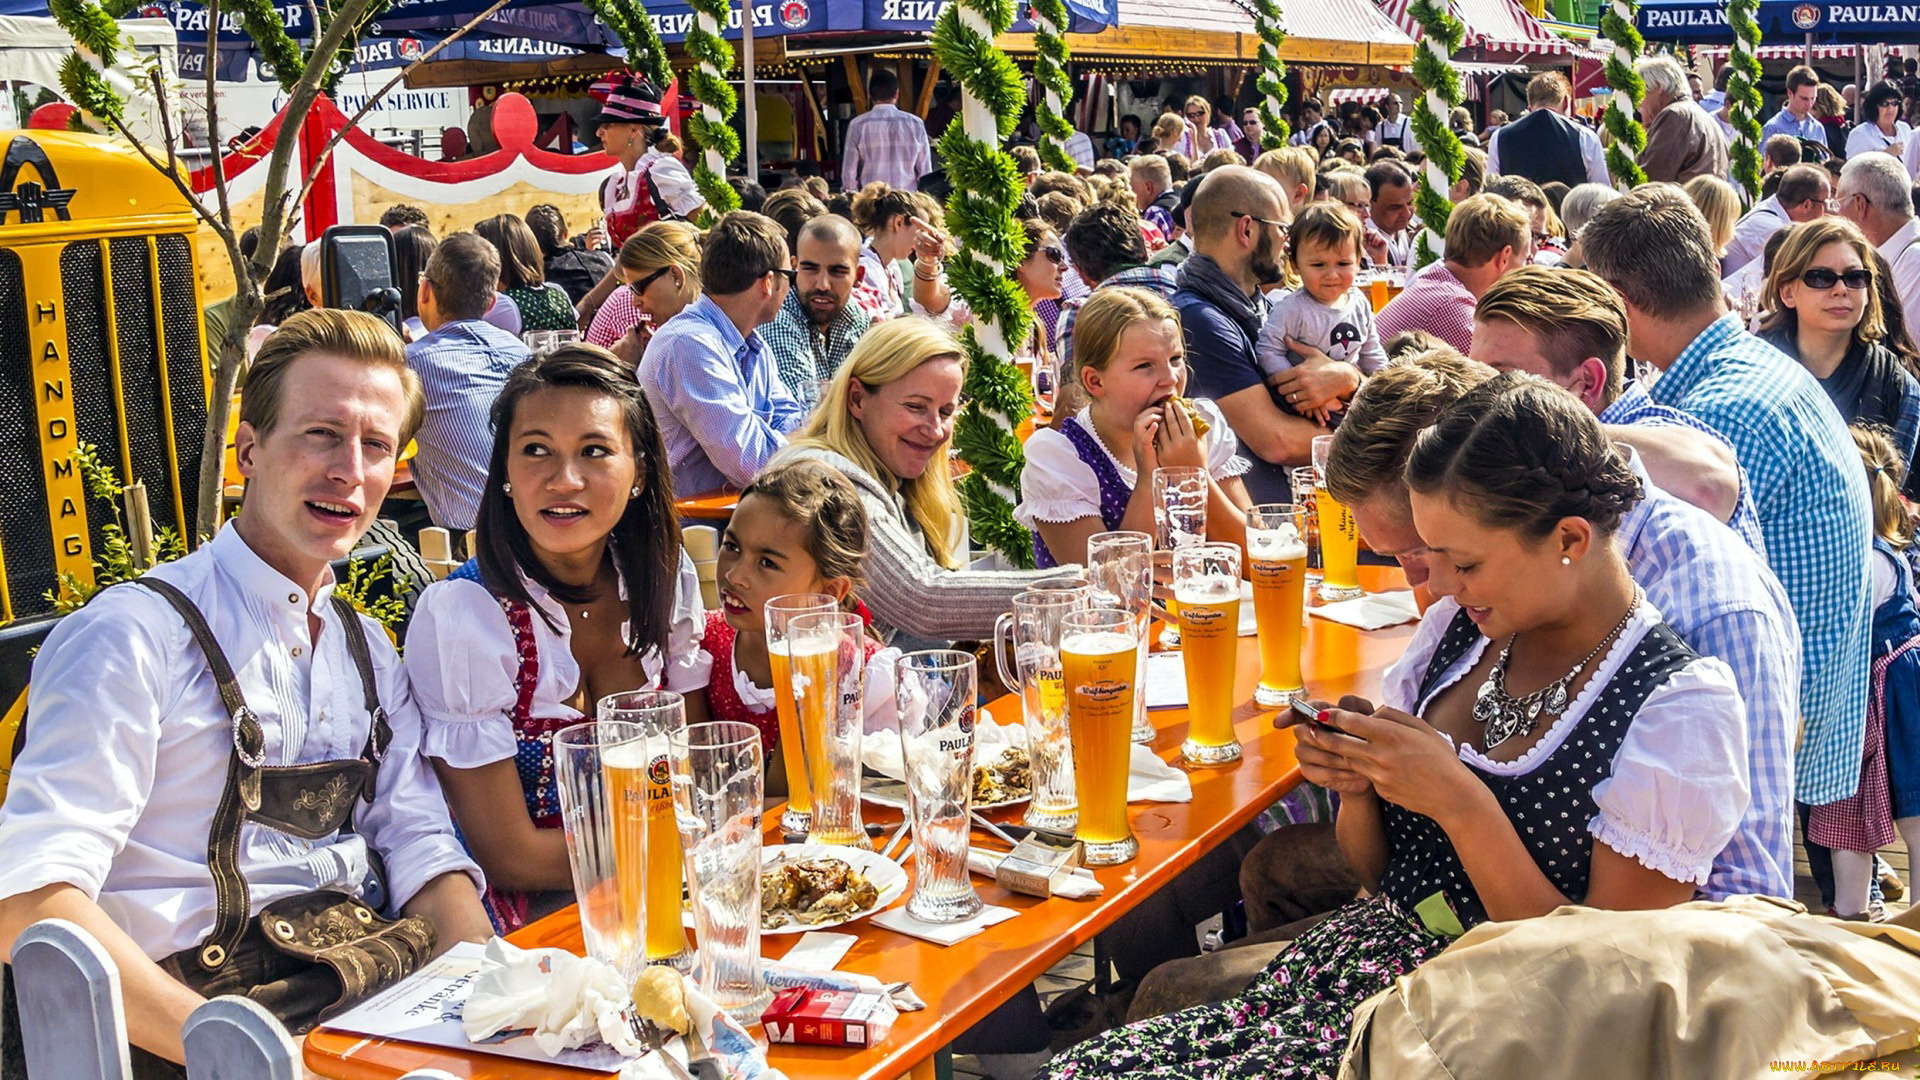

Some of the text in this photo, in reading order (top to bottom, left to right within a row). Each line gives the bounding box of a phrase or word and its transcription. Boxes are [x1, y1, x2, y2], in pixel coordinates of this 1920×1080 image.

[175, 5, 302, 31] PALR
[1646, 8, 1760, 27] PAULANR
[1828, 5, 1920, 23] PAULAN
[387, 92, 450, 111] SERVICE
[37, 300, 83, 557] HANOMAG
